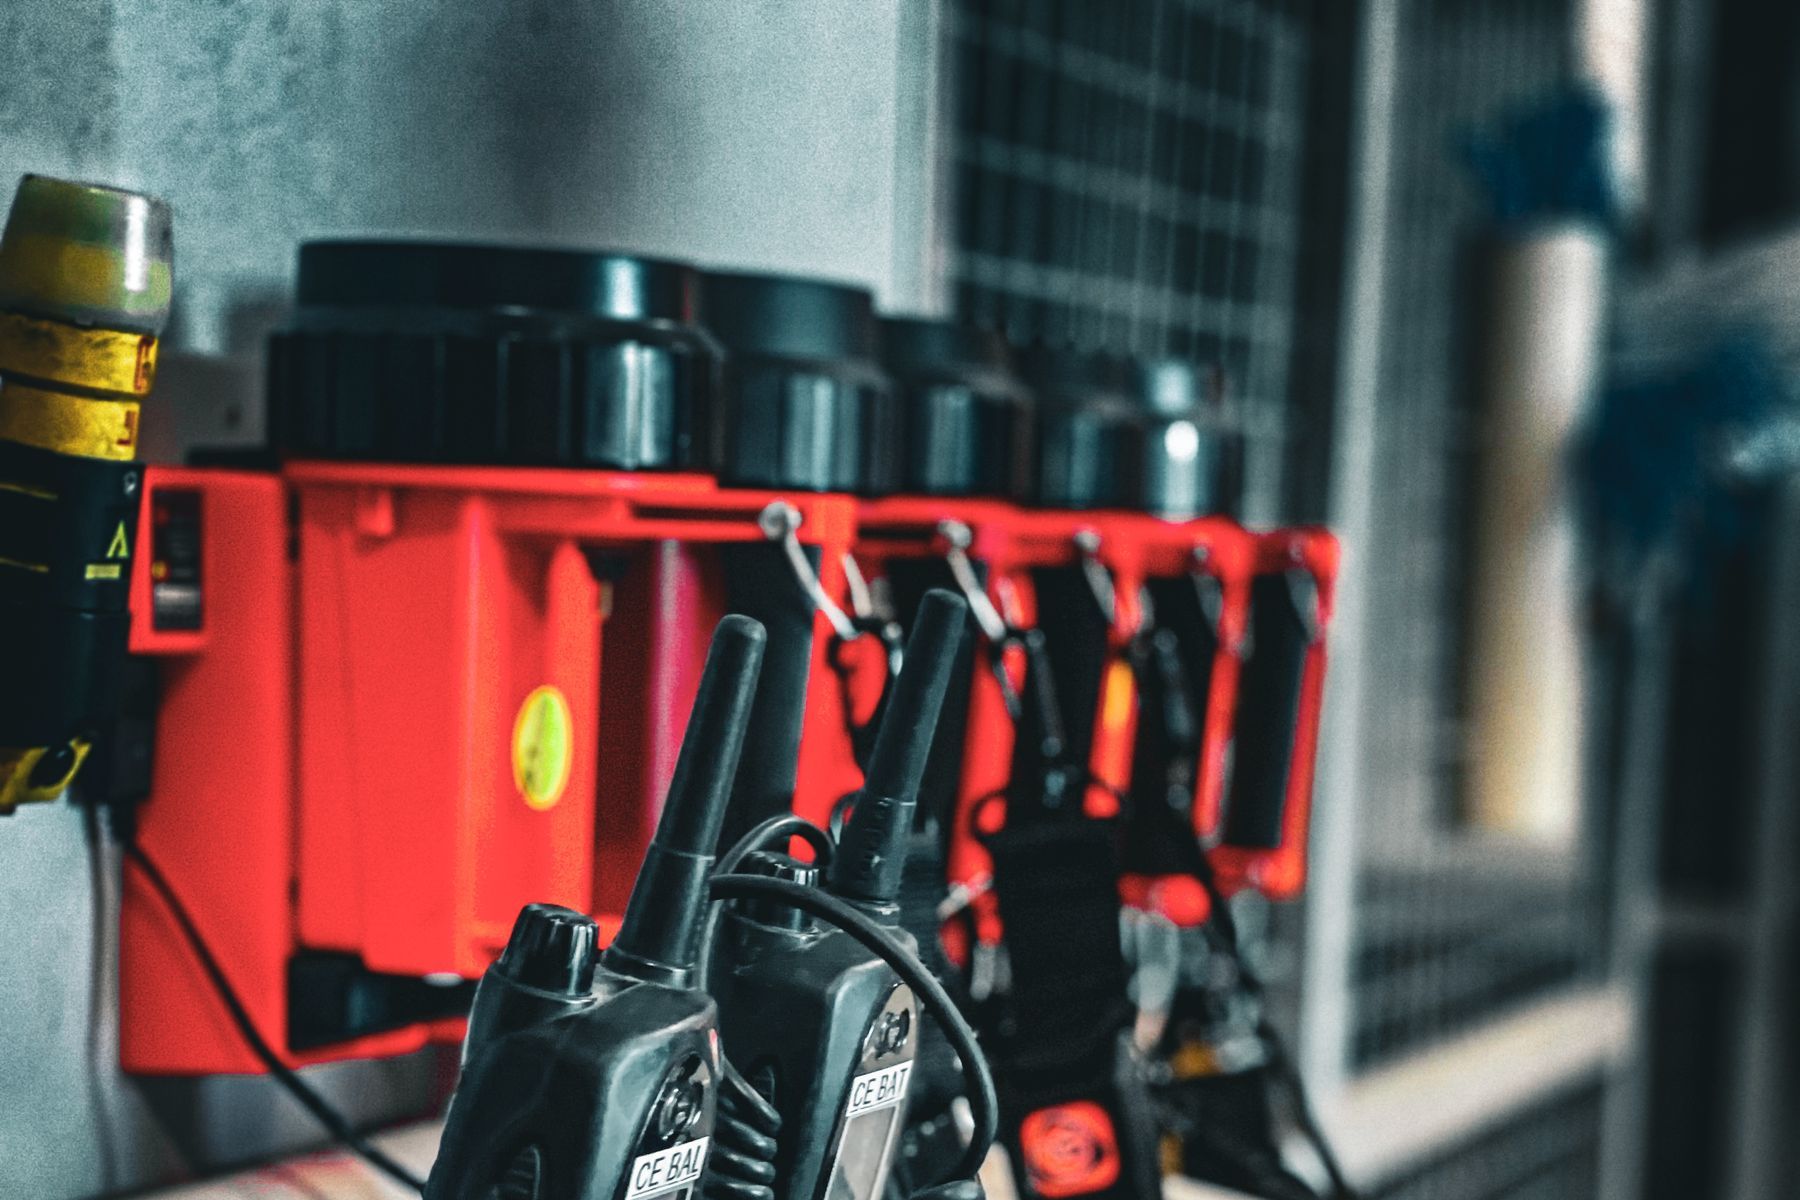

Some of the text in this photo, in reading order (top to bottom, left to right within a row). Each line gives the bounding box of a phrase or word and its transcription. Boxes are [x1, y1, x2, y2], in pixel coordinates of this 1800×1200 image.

[853, 1068, 908, 1107] CE BAT
[637, 1145, 701, 1191] CE BAL
